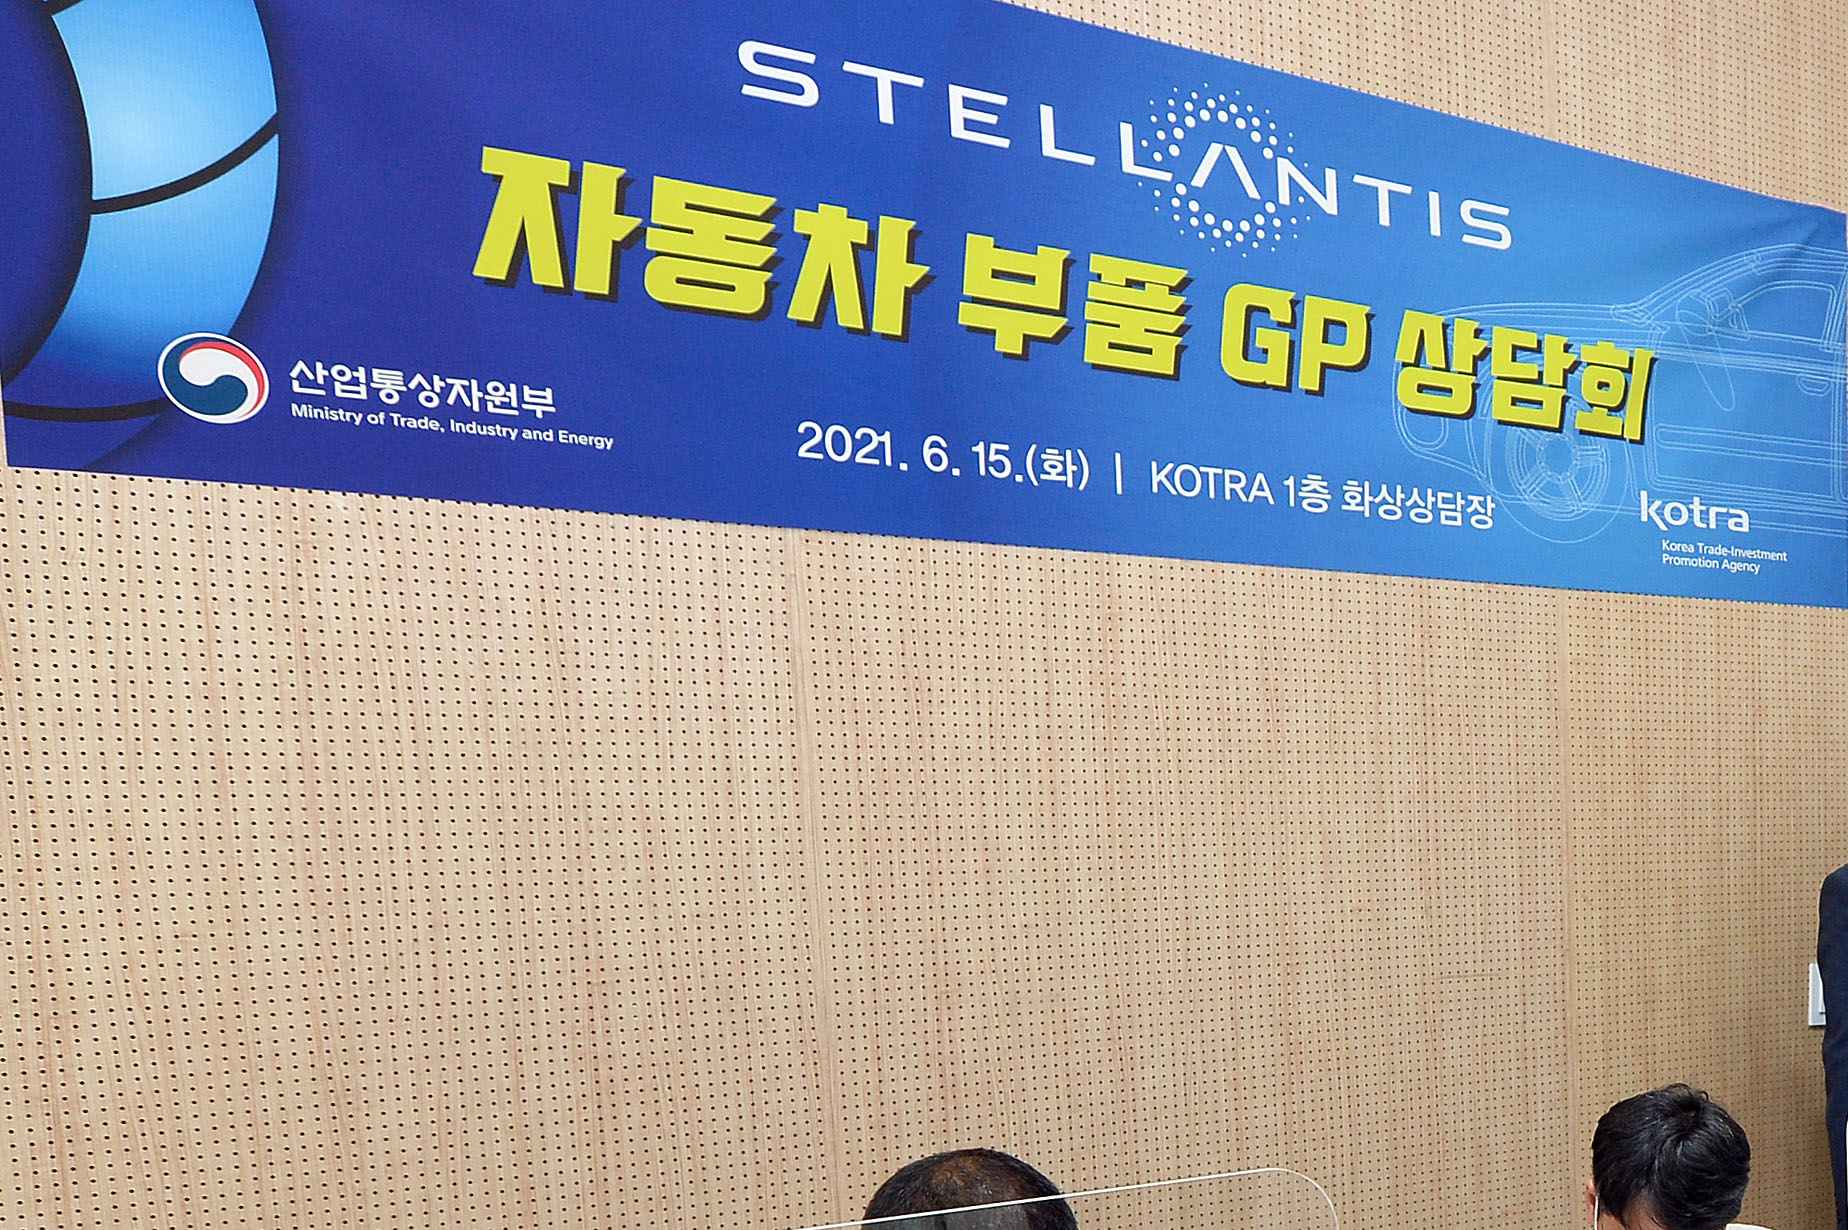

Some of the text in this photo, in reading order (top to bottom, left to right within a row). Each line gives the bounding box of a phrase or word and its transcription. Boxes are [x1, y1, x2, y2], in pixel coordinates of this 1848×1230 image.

[738, 40, 1513, 251] STELLANTIS
[473, 146, 1654, 443] 자동차 부품 GP 상담회
[289, 359, 557, 418] 산업통상자원부
[291, 402, 614, 451] Ministry of Trade, Industry and Energy
[797, 420, 909, 472] 2021.
[922, 434, 961, 476] 6.
[1150, 460, 1275, 505] KOTRA
[1283, 473, 1332, 514] 1층
[1340, 479, 1496, 530] 화상상담장
[1640, 490, 1750, 533] kotra
[1662, 539, 1788, 562] Korea Trade-Investment
[1662, 553, 1761, 575] Promotion Agency
